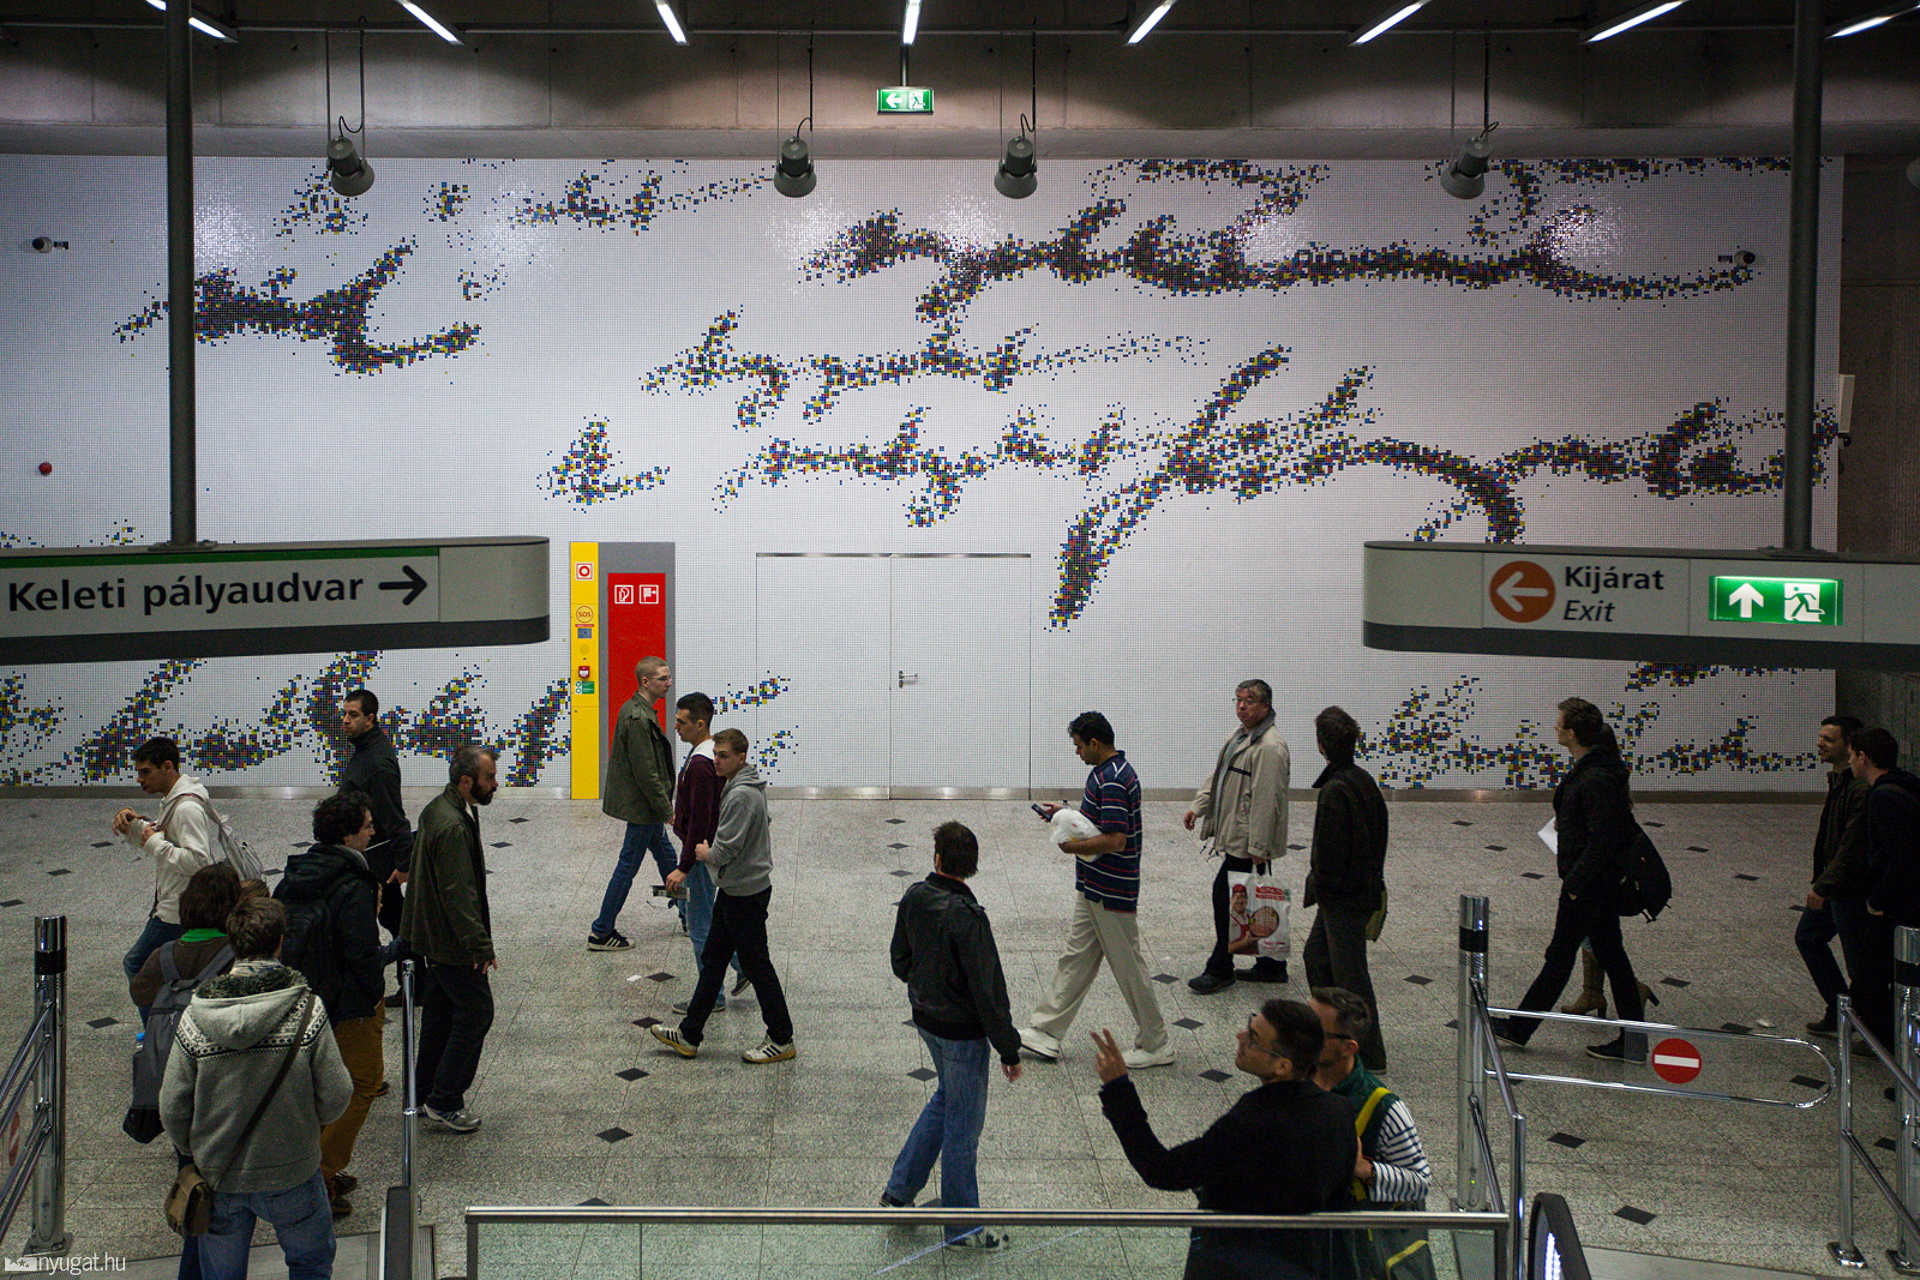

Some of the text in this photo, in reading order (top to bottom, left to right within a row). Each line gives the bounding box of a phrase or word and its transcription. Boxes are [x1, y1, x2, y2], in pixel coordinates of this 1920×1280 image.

[1565, 566, 1664, 594] Kijárat
[8, 573, 364, 616] Keleti pályaudvar
[1563, 600, 1615, 622] Exit
